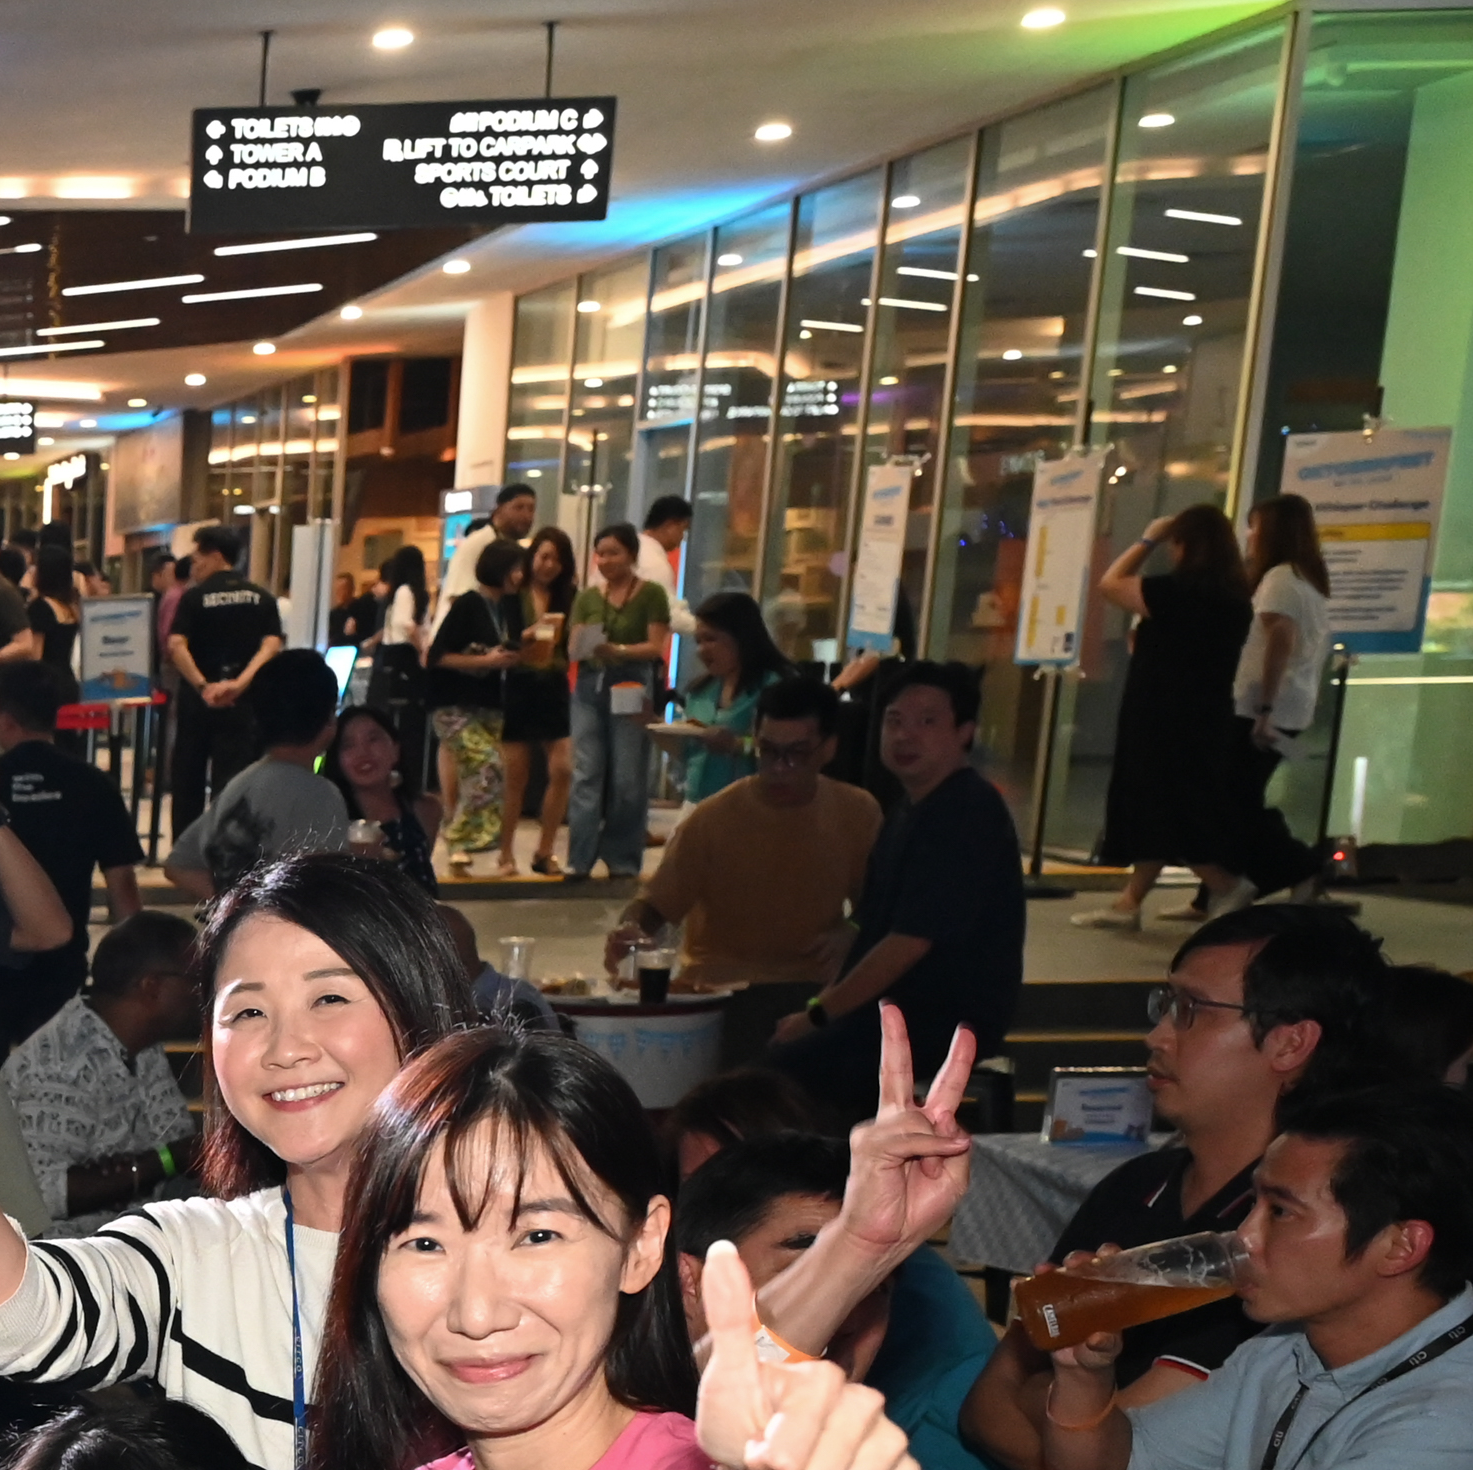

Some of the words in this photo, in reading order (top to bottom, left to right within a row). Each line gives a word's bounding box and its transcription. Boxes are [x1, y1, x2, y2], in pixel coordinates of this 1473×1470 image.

[231, 115, 314, 139] TOILETS
[479, 109, 559, 132] PODIUM
[560, 108, 579, 131] C
[230, 142, 304, 164] TOWER
[305, 141, 323, 162] A
[404, 137, 447, 160] LIFT
[448, 137, 478, 158] TO
[479, 134, 577, 157] CARPARK
[228, 167, 308, 189] PODIUM
[309, 166, 326, 187] B
[414, 161, 497, 184] SPORTS
[498, 159, 571, 181] COURT
[488, 183, 572, 207] TOILETS
